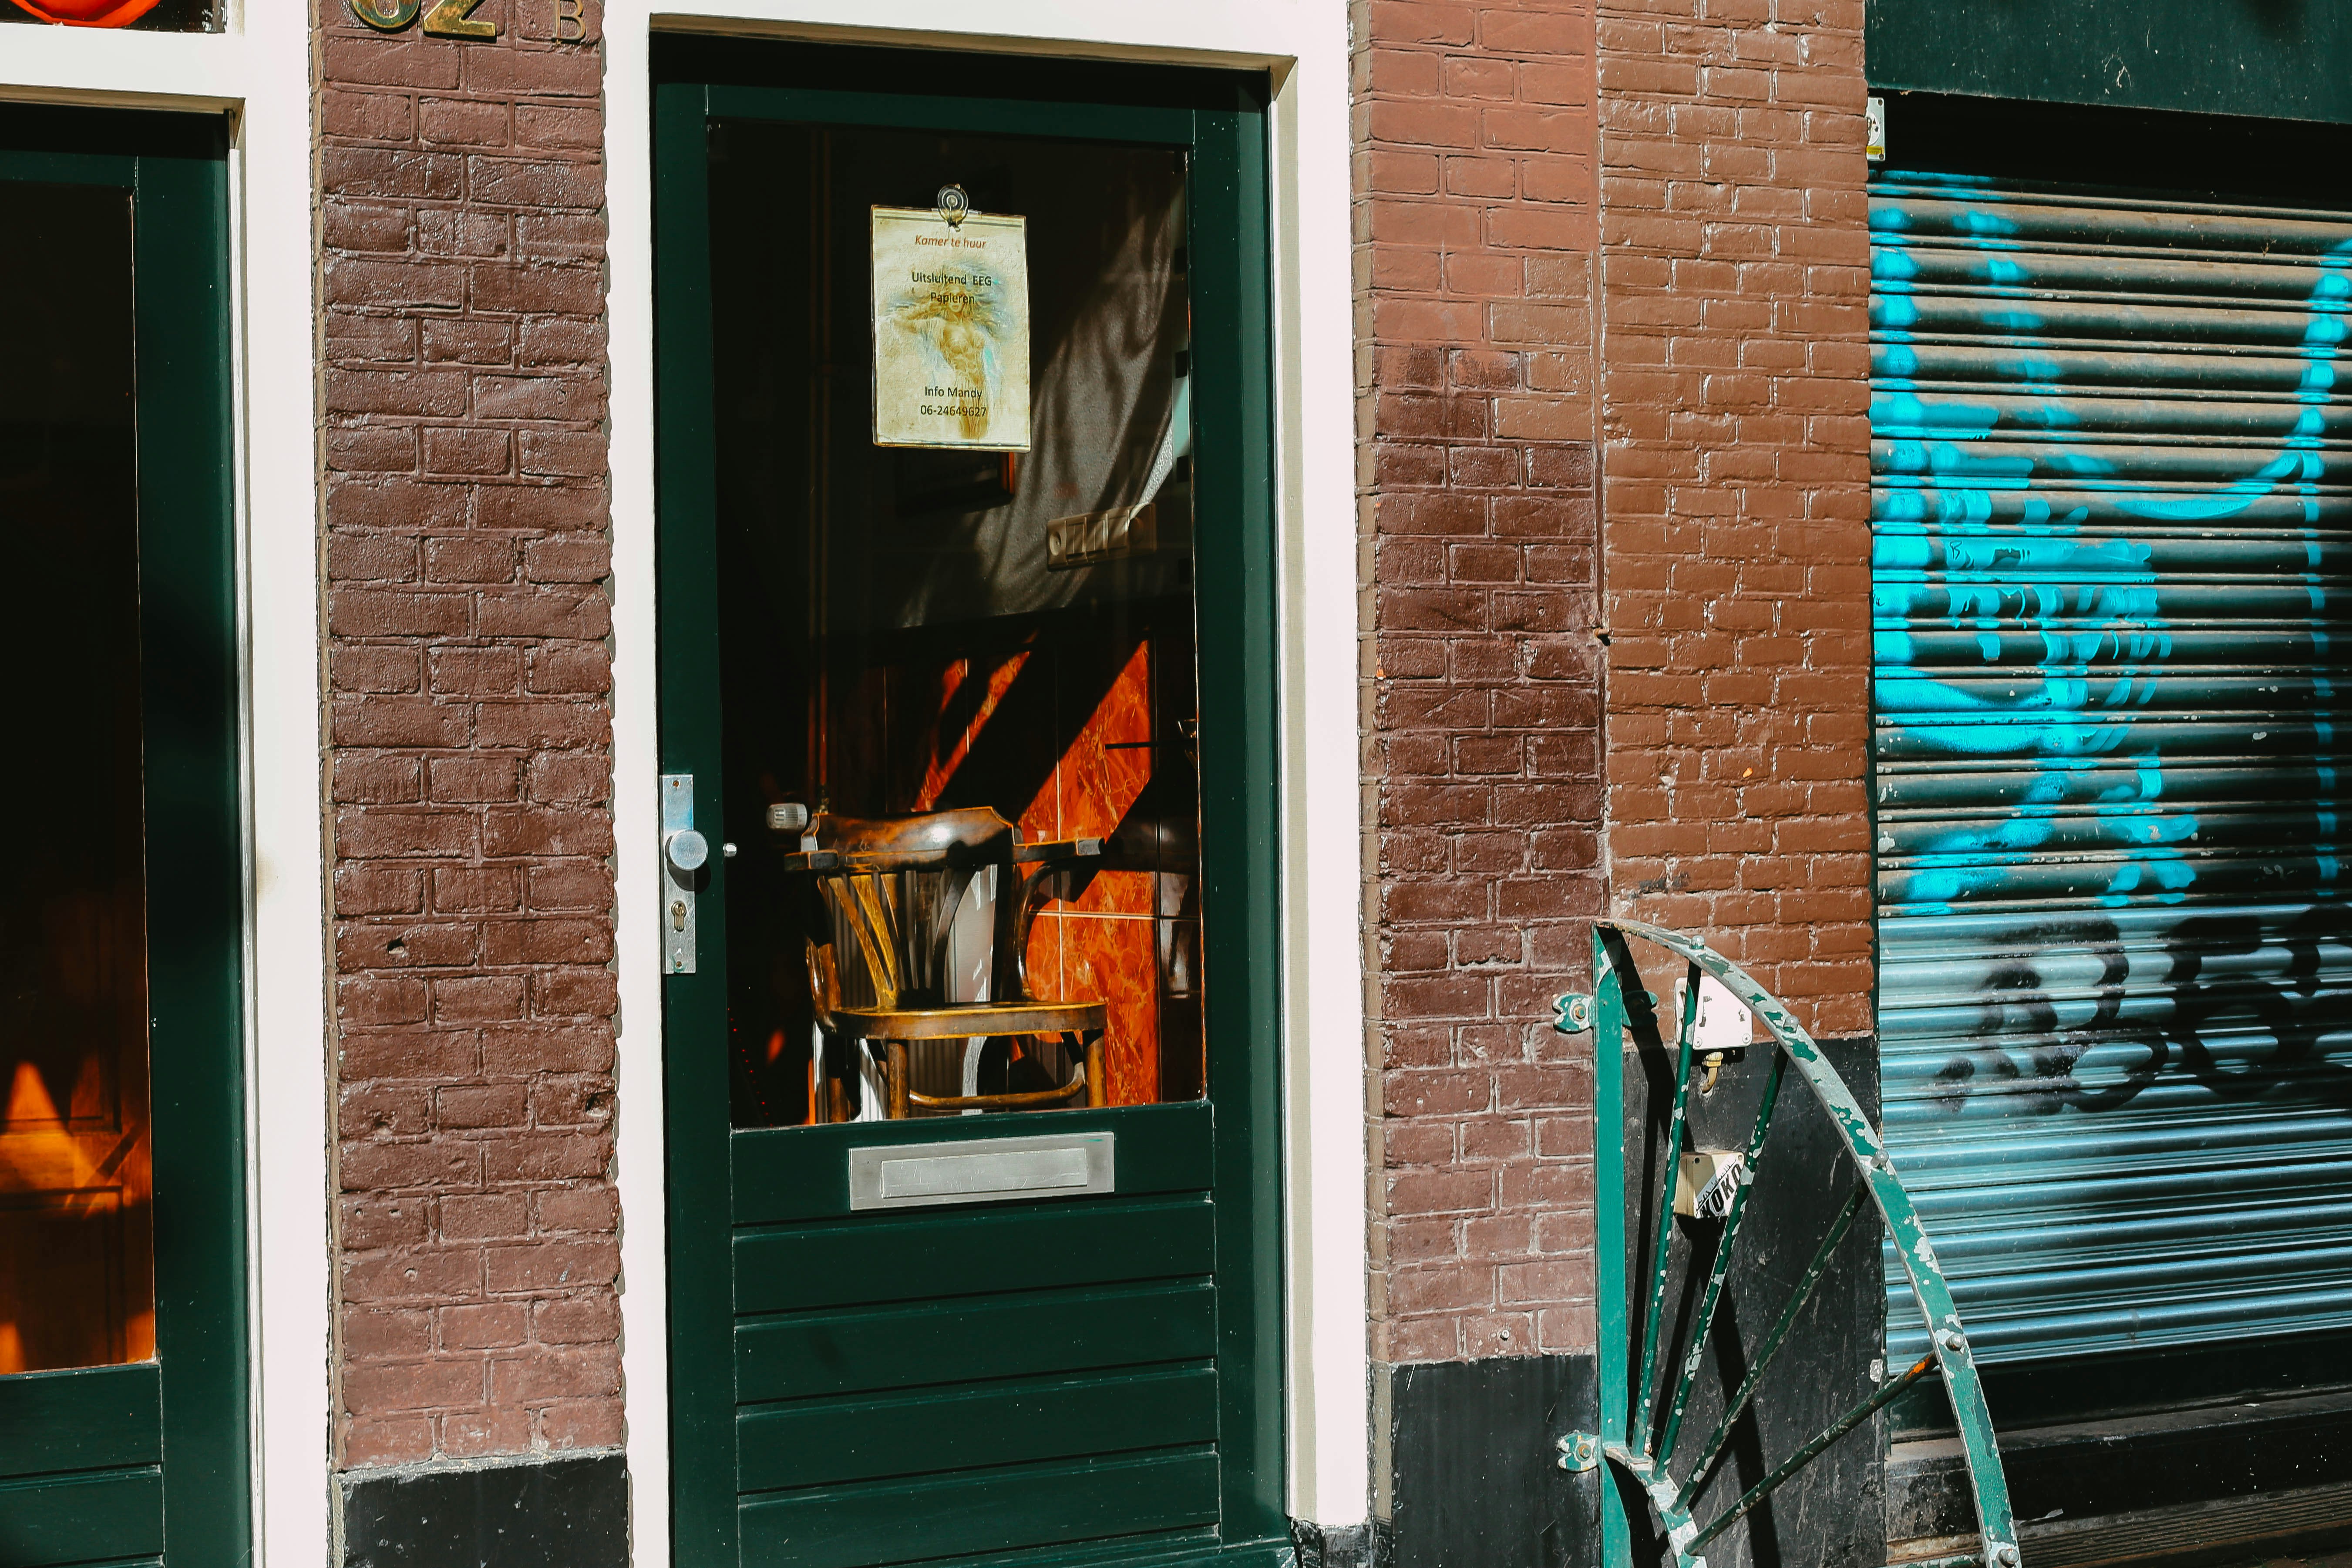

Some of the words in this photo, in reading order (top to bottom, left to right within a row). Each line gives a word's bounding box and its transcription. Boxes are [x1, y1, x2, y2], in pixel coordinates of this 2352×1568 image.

[915, 235, 948, 246] Kamer
[951, 237, 960, 247] te
[963, 237, 987, 249] huur
[912, 272, 967, 285] Uitsluitend
[973, 275, 992, 286] EEG
[931, 292, 975, 304] Papieren
[925, 386, 944, 397] Info
[948, 387, 982, 401] Mandy
[920, 404, 986, 417] 06-24649627
